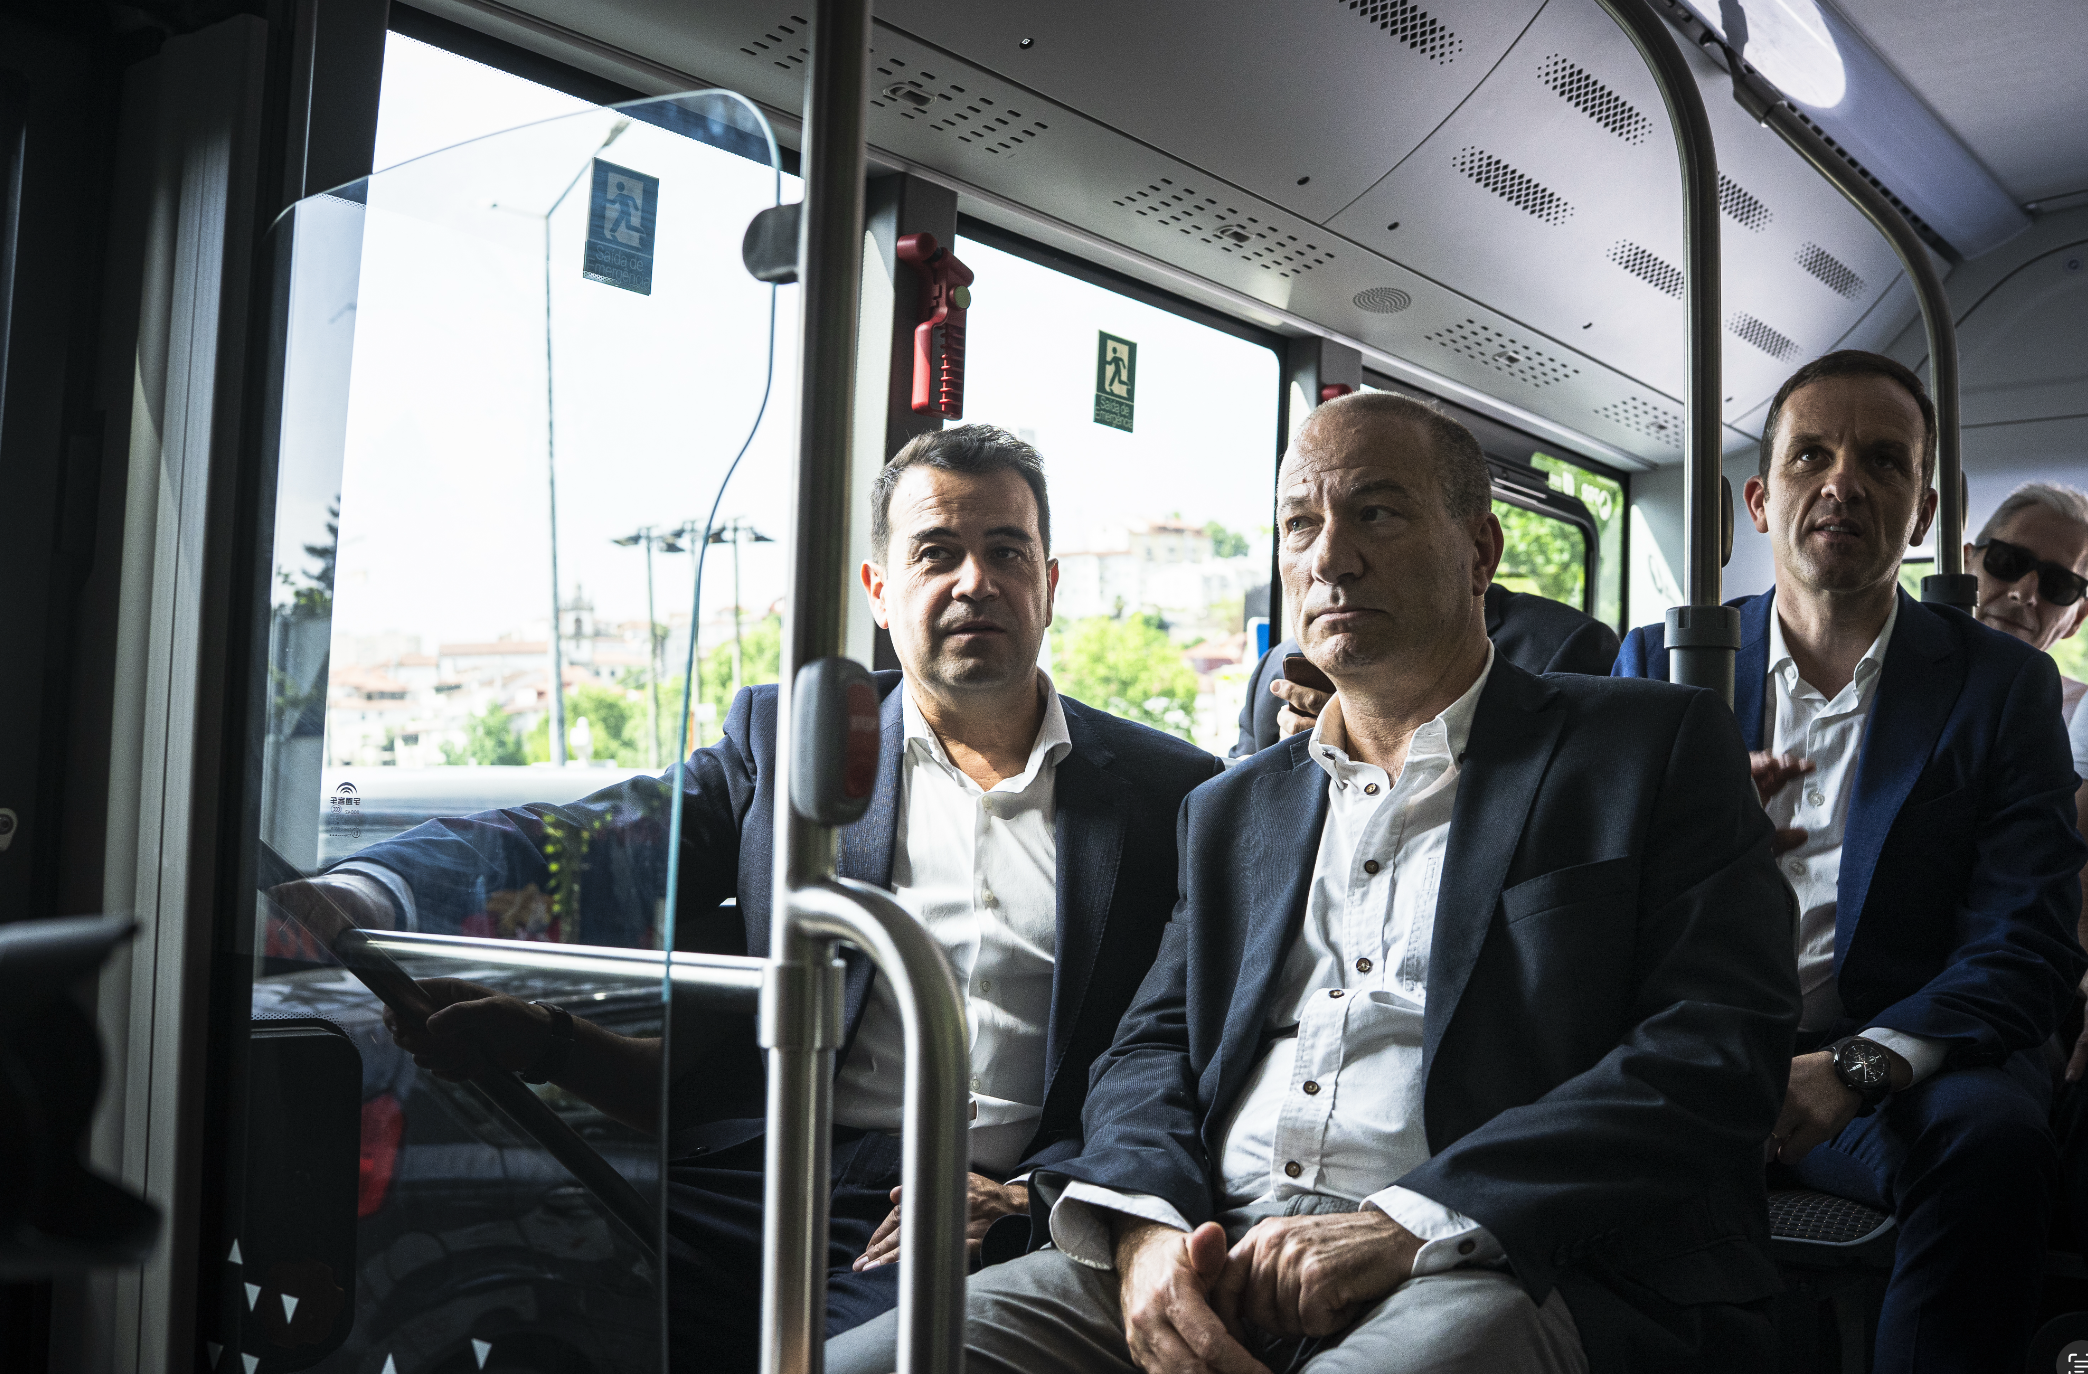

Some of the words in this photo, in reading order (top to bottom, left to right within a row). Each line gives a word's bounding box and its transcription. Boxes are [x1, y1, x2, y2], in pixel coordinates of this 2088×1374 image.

[586, 257, 651, 287] Emergência
[595, 244, 628, 268] Saída
[629, 256, 644, 272] de
[1100, 396, 1120, 413] Saída
[1120, 404, 1130, 416] de
